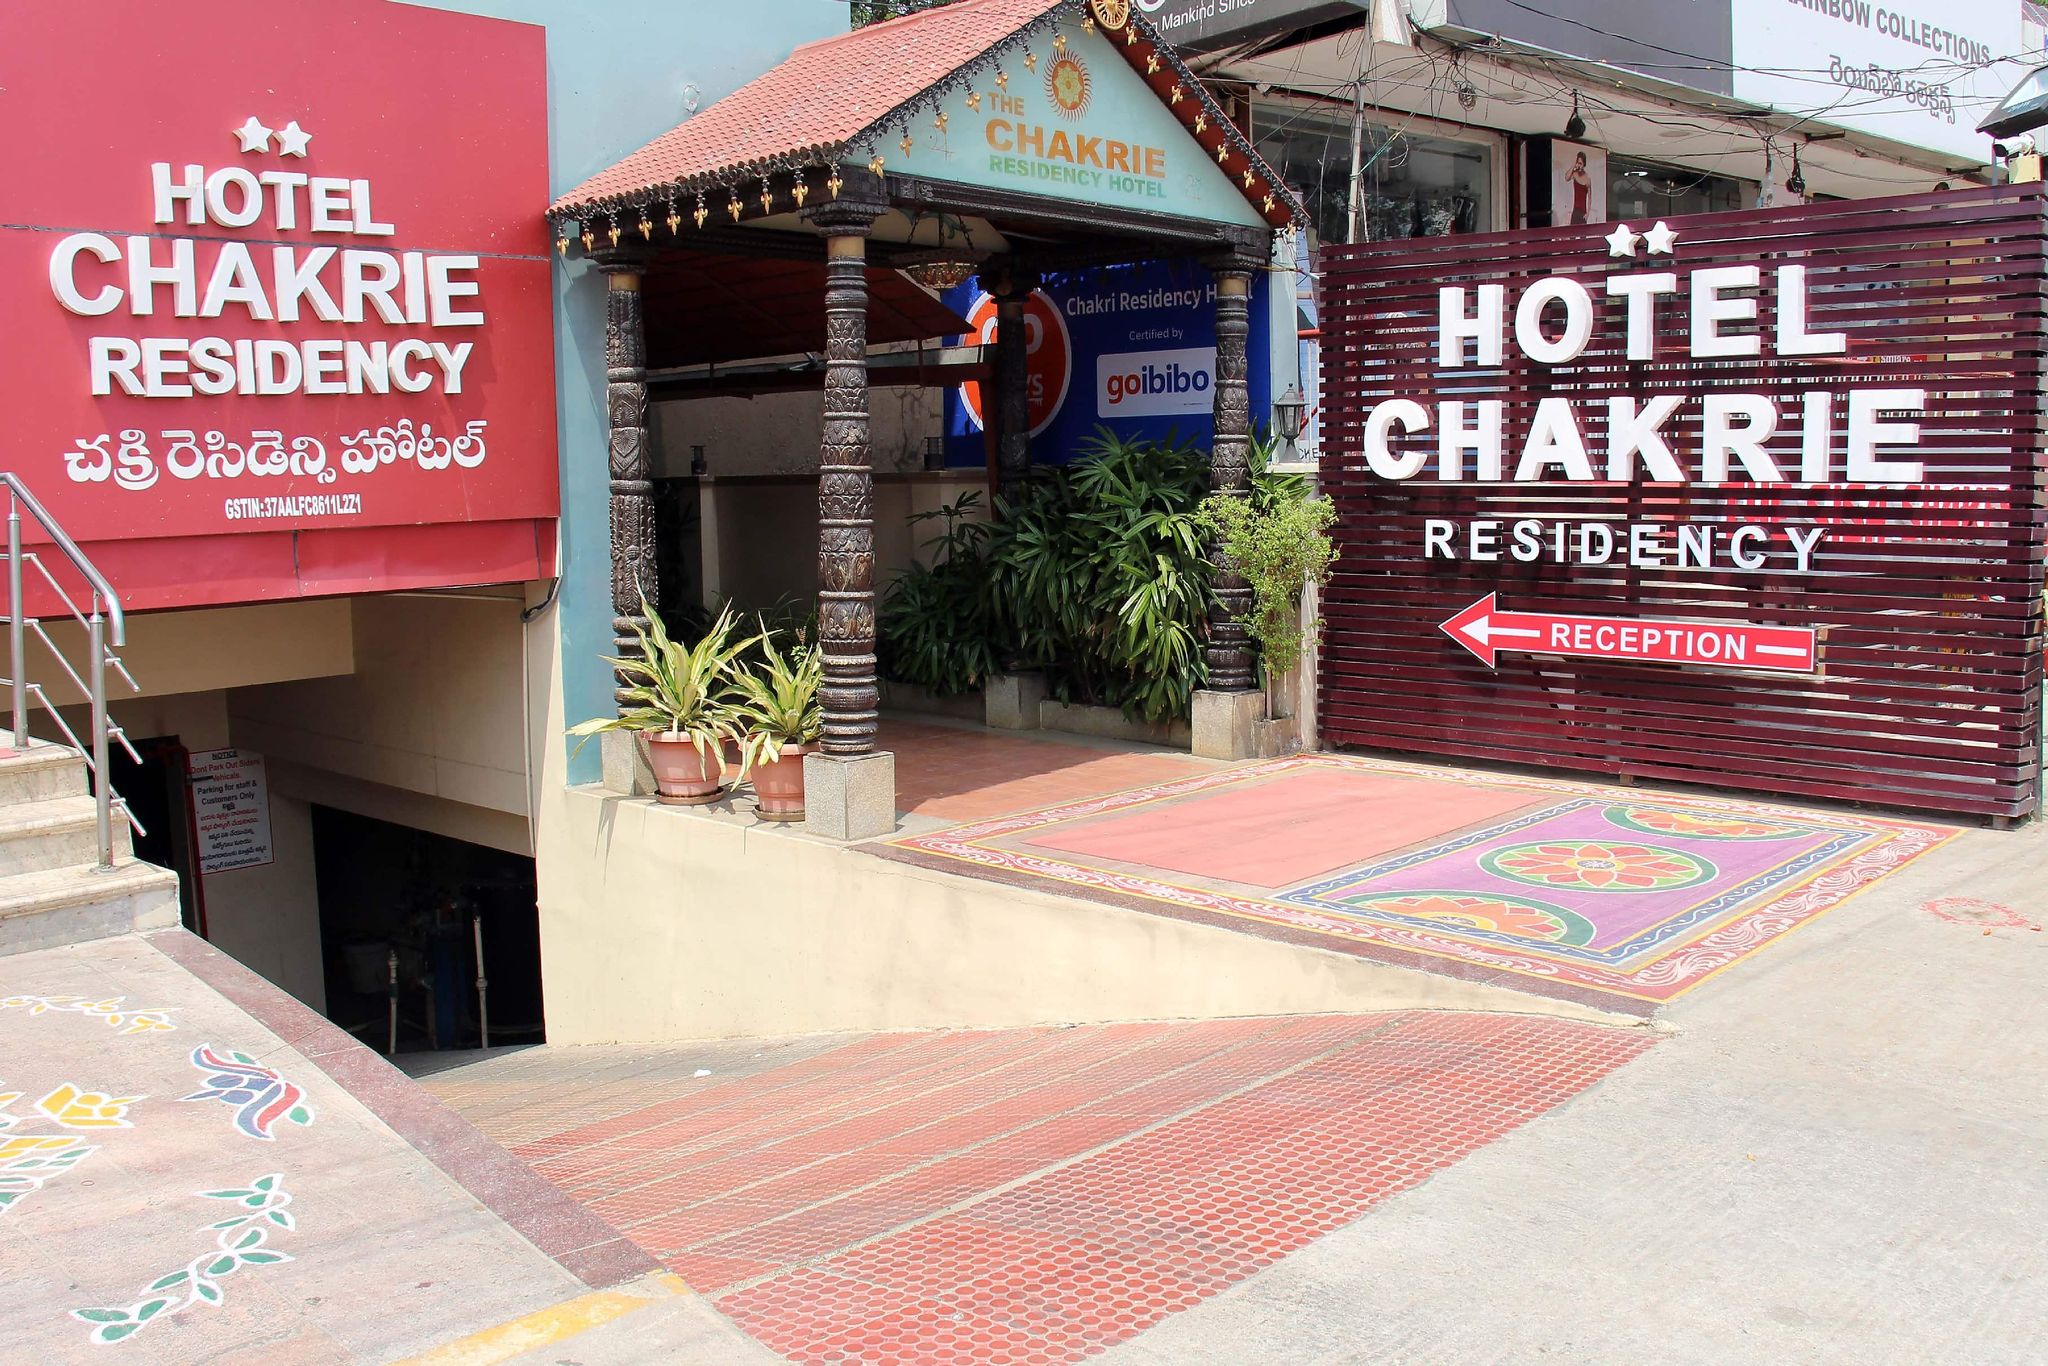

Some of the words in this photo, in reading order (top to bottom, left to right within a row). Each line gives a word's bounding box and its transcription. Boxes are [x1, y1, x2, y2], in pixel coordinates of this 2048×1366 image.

[1161, 0, 1215, 31] Mankind
[1788, 0, 1870, 28] NBOW
[1876, 8, 1990, 63] COLLECTIONS
[987, 92, 1025, 116] THE
[985, 118, 1166, 178] CHAKRIE
[989, 154, 1102, 188] RESIDENCY
[1109, 175, 1167, 199] HOTEL
[151, 162, 395, 236] HOTEL
[49, 232, 484, 327] CHAKRIE
[1066, 295, 1116, 317] Chakri
[1119, 287, 1201, 311] Residency
[1439, 264, 1847, 367] HOTEL
[1128, 328, 1170, 342] Certified
[1172, 327, 1184, 340] by
[89, 336, 473, 398] RESIDENCY
[1106, 363, 1210, 404] goibibo
[63, 428, 159, 491] చక్రి
[161, 429, 337, 484] రెసిడెన్సి
[340, 418, 488, 473] హోటల్
[1364, 388, 1926, 484] CHAKRIE
[1424, 519, 1830, 572] RESIDENCY
[1551, 622, 1748, 661] RECEPTION
[208, 763, 224, 772] Park
[225, 761, 238, 769] Out
[212, 751, 238, 760] NOTICE
[197, 785, 224, 795] Parking
[224, 783, 234, 791] for
[236, 780, 251, 789] staff
[201, 794, 238, 806] Customers
[239, 791, 255, 800] Only
